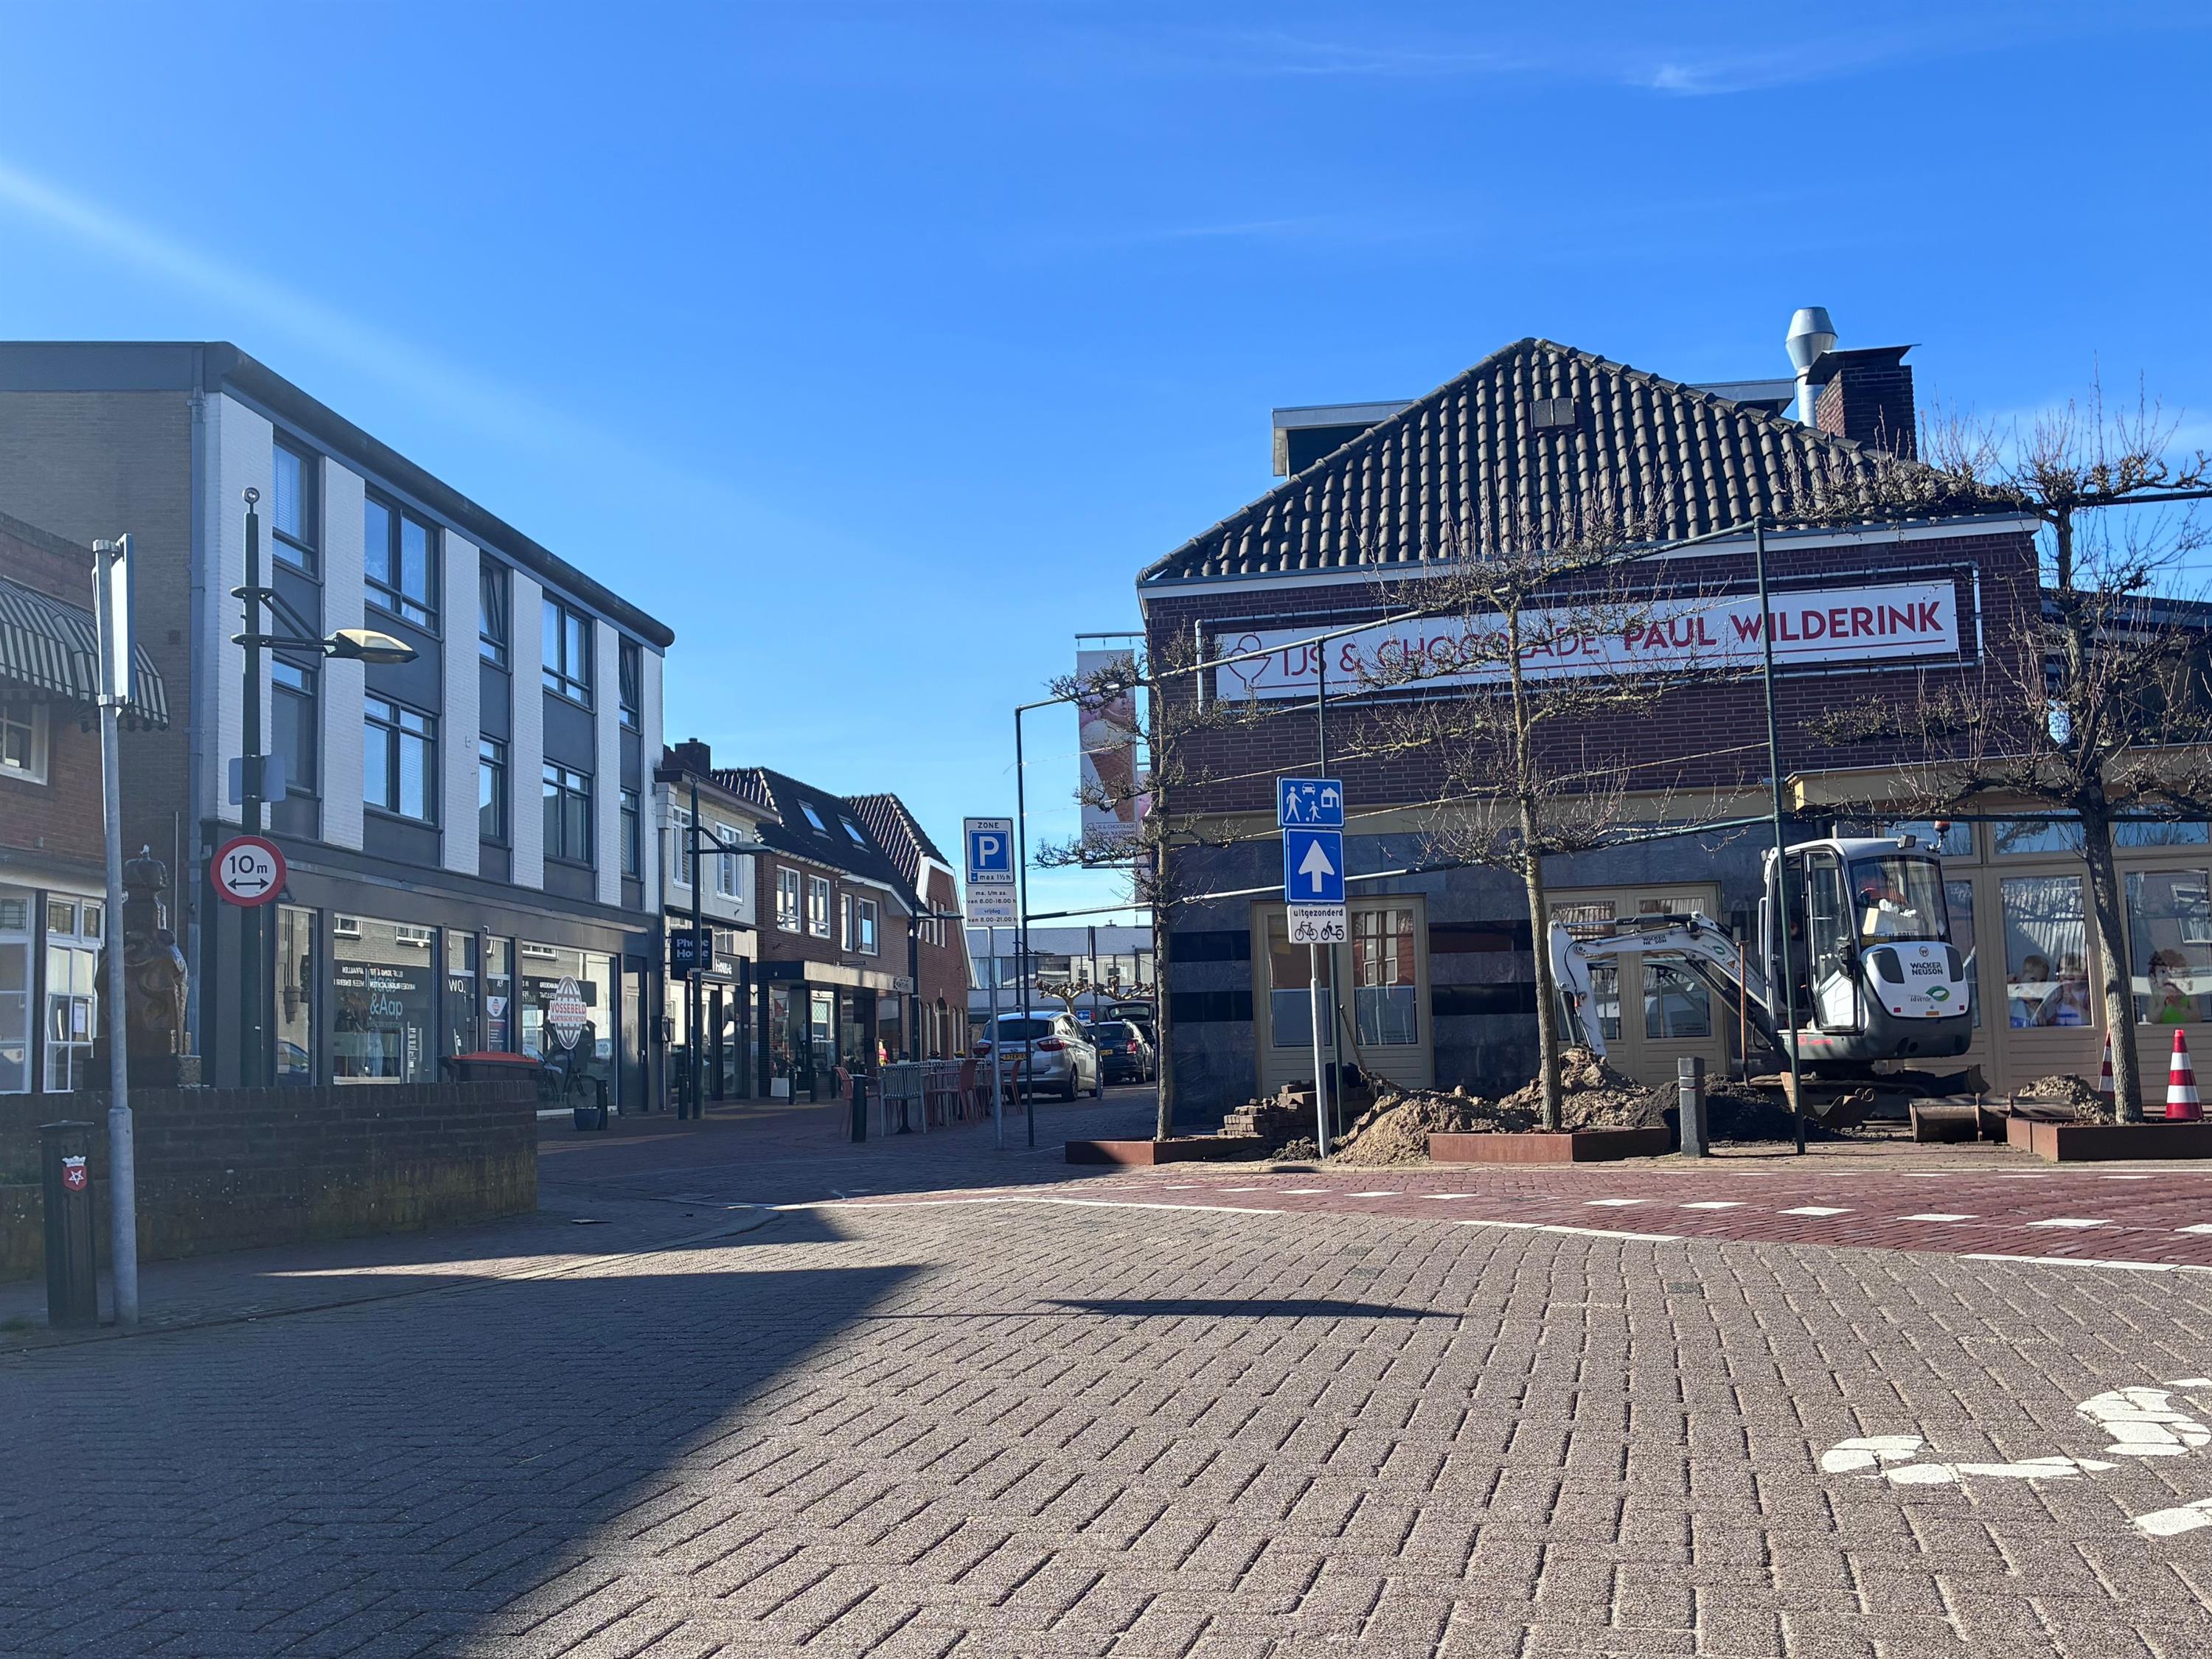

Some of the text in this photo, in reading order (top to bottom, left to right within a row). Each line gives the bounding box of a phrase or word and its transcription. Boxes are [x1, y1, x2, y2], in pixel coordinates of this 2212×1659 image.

[1284, 645, 1327, 676] IJS
[1340, 643, 1363, 672] &
[1623, 616, 1717, 650] PAUL
[1731, 602, 1944, 644] WILDERINK
[979, 836, 999, 866] P
[1293, 908, 1343, 919] uitgezonderd
[370, 993, 403, 1019] &Aap
[550, 1002, 587, 1015] VOSSEBELD
